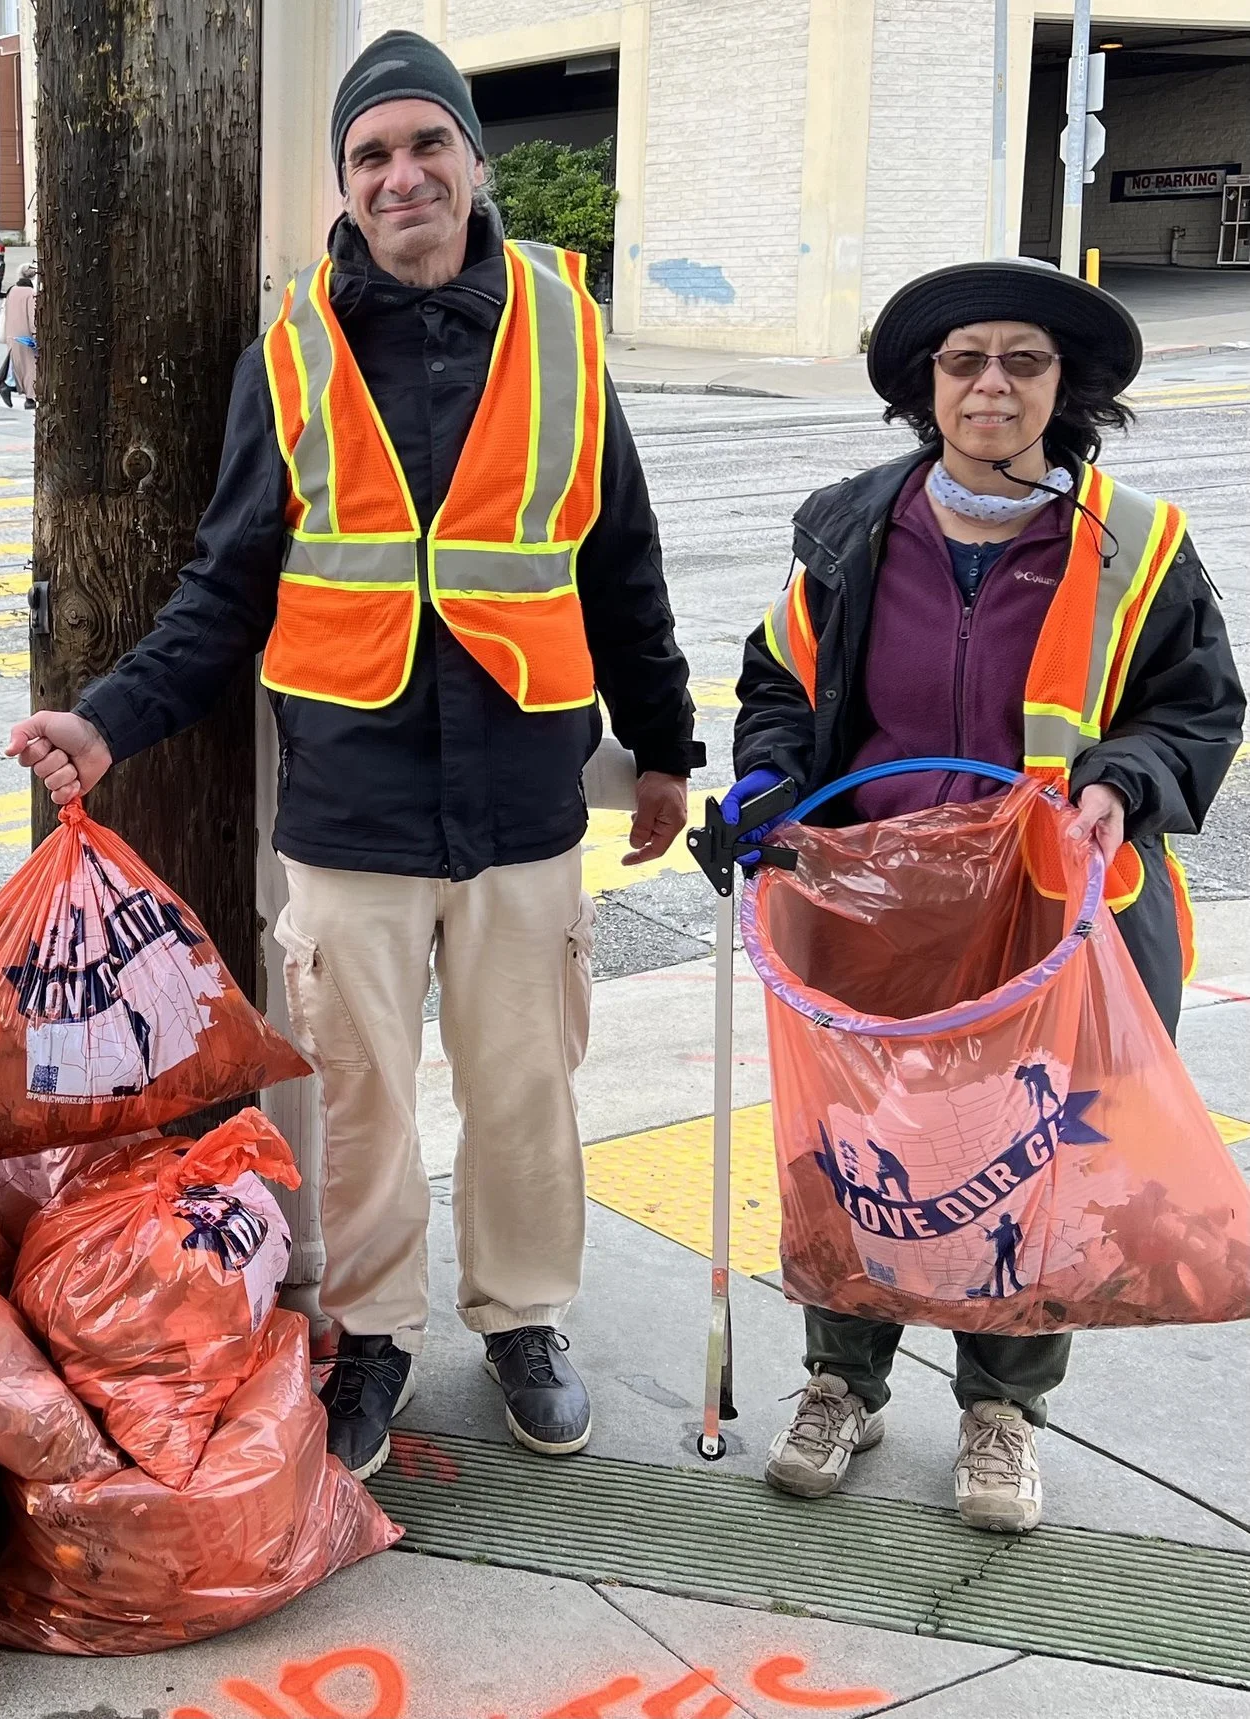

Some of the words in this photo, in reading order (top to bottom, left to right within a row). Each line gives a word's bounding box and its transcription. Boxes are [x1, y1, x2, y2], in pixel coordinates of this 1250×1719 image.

[1132, 175, 1150, 190] NO
[1155, 172, 1218, 189] PARKING
[936, 1162, 1020, 1226] OUR
